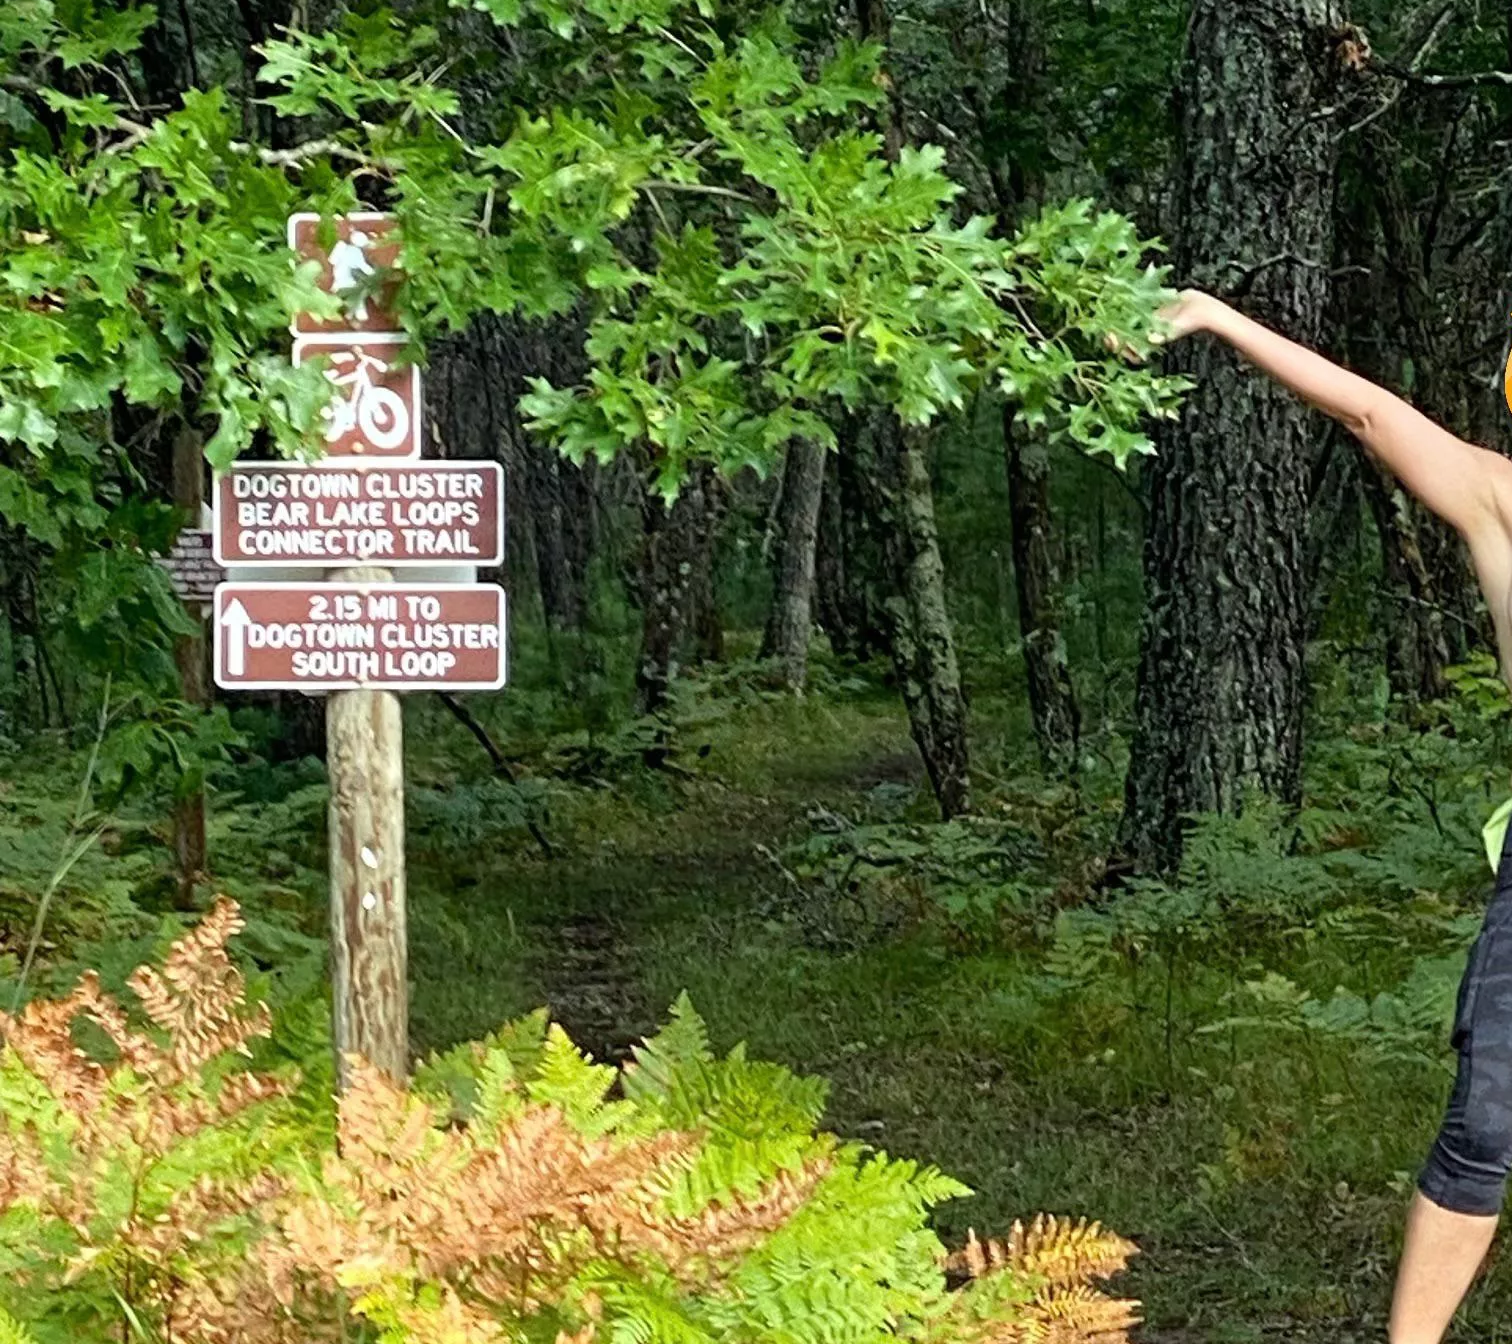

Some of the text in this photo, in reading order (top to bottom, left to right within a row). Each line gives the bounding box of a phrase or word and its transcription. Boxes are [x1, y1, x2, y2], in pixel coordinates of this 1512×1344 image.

[233, 474, 483, 498] DOGTOWN CLUSTER
[238, 503, 480, 527] BEAR LAKE LOOPS
[238, 530, 479, 555] CONNECTOR TRAIL
[308, 596, 441, 620] 2.15 MI TO
[248, 624, 499, 648] DOGTOWN CLUSTER
[291, 652, 456, 677] SOUTH LOOP
